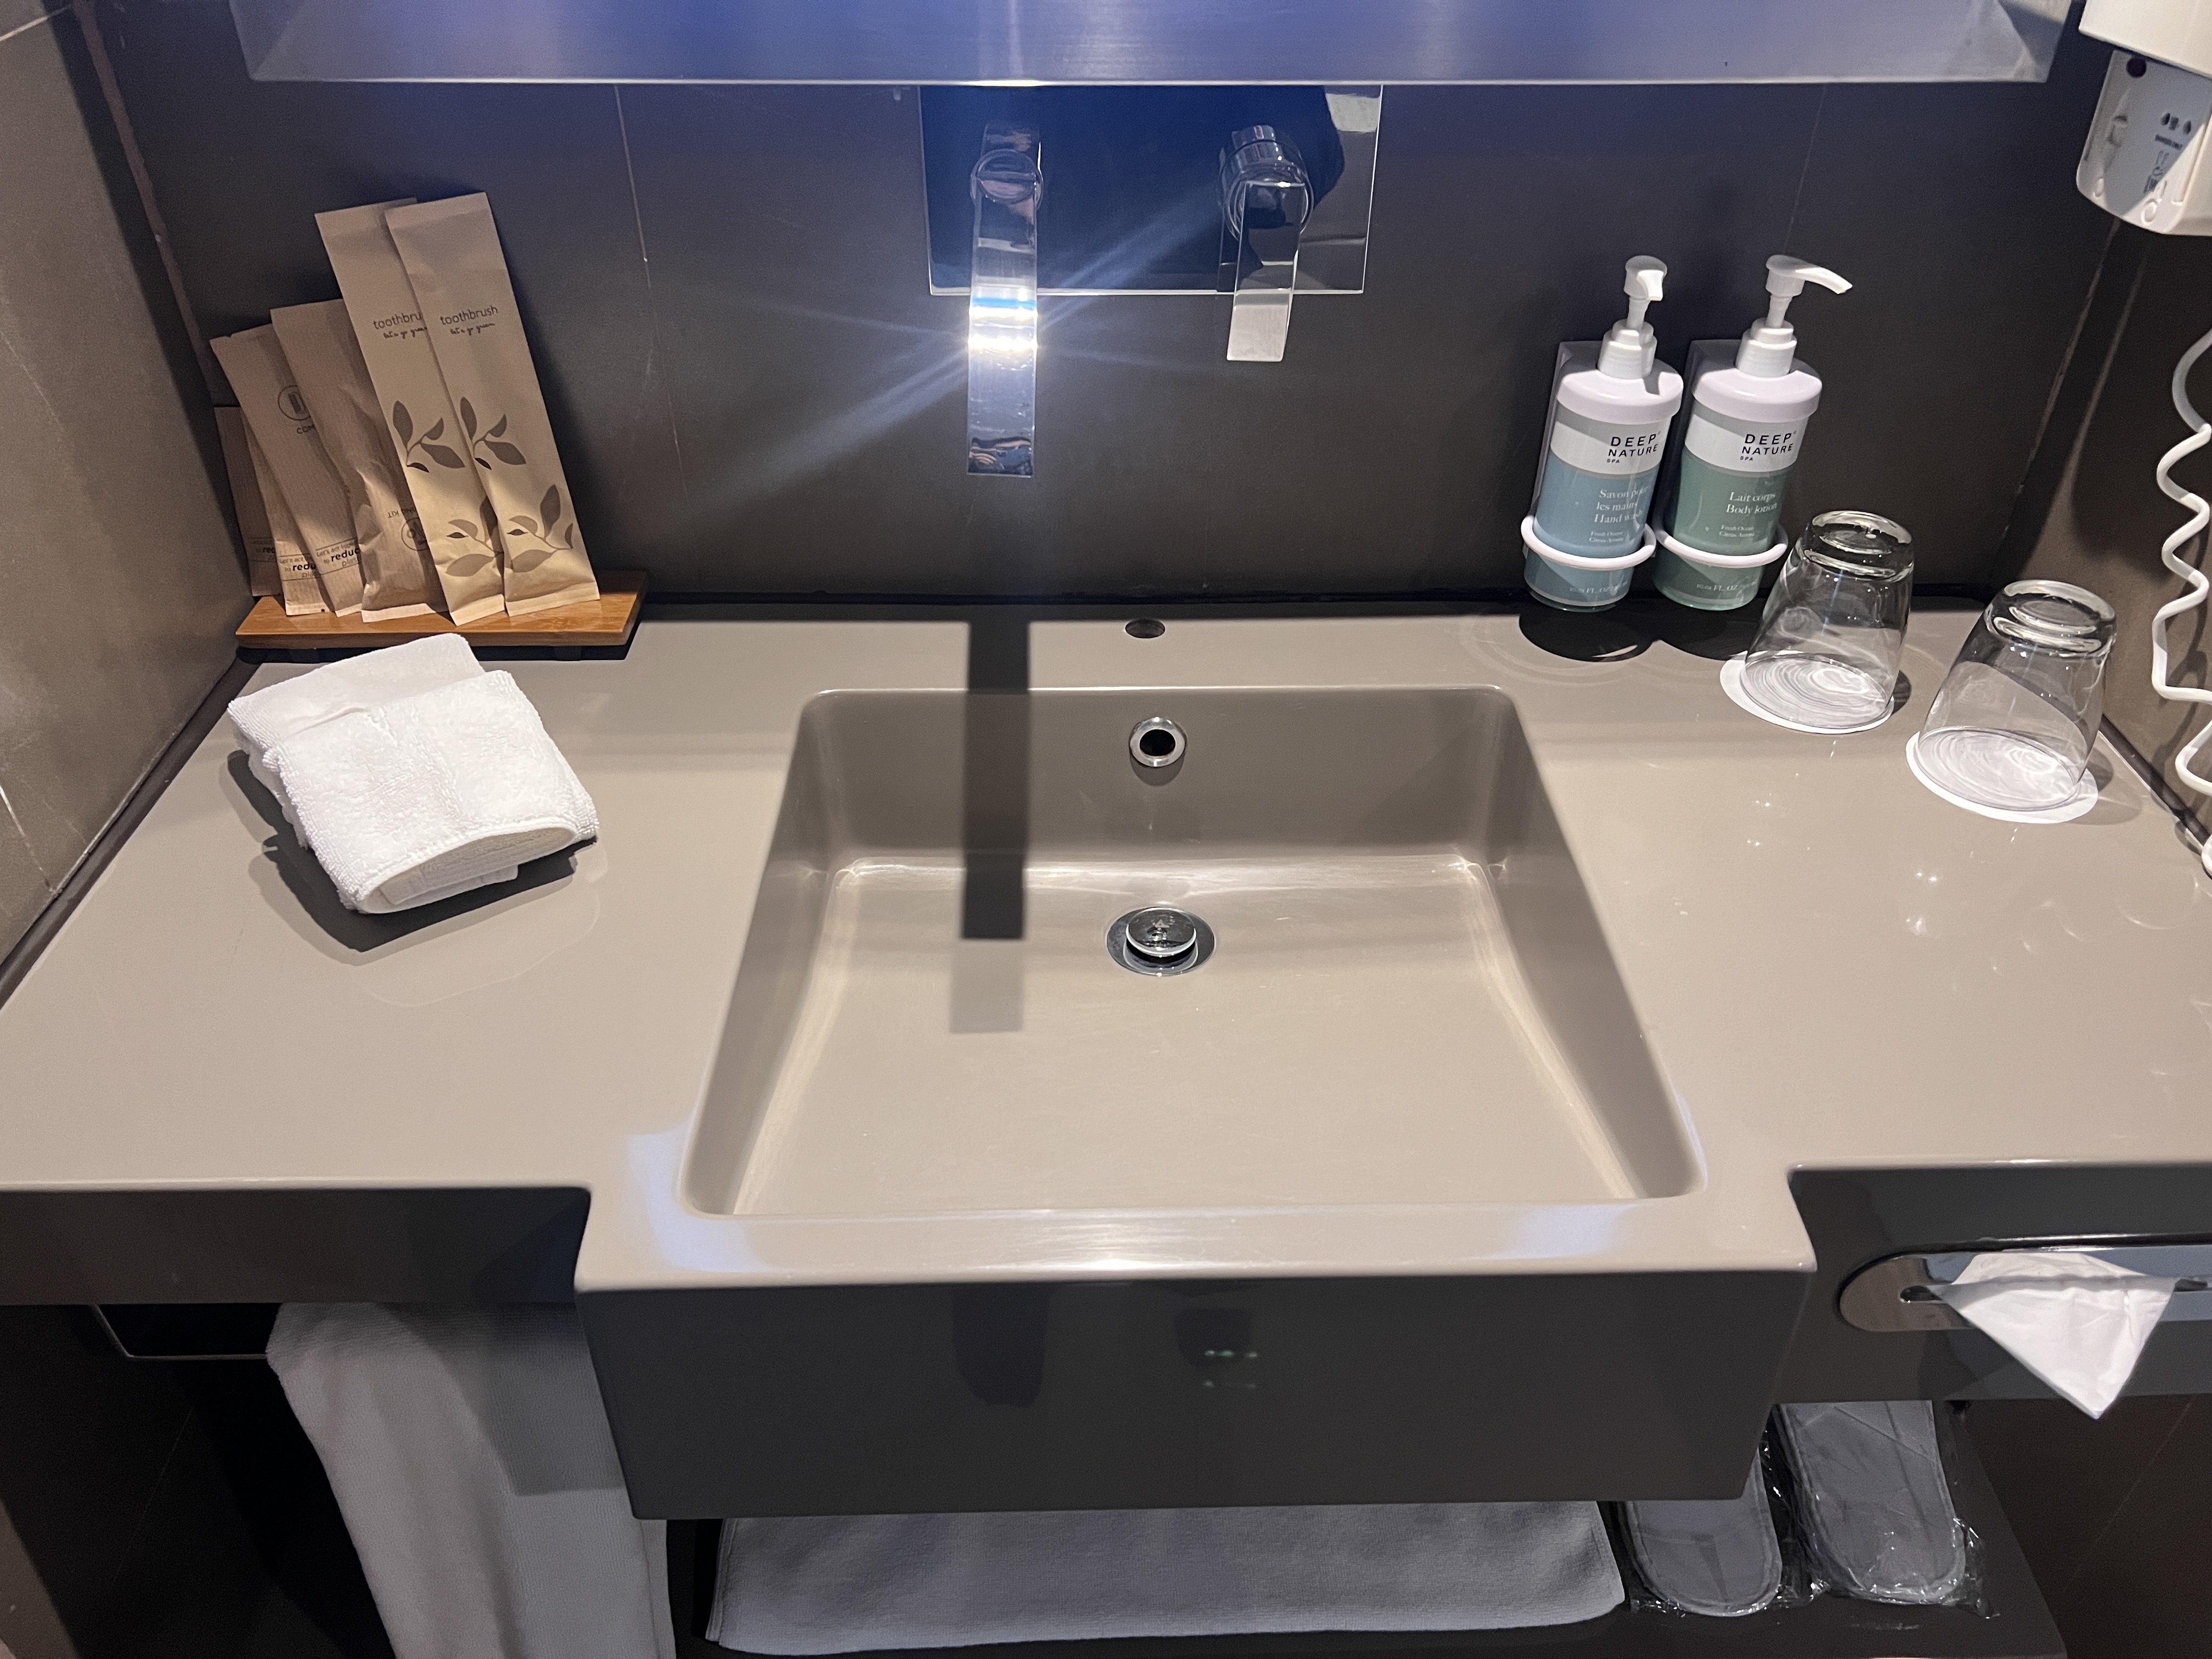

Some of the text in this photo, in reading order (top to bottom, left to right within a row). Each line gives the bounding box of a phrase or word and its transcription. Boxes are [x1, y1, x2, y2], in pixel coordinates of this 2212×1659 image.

[440, 305, 498, 325] toothbrush
[373, 312, 422, 330] toothbru
[297, 424, 315, 434] COM
[1611, 434, 1656, 447] DEEP
[1745, 433, 1792, 445] DEEP
[1608, 444, 1658, 457] NATURE
[1741, 443, 1793, 455] NATURE
[1599, 489, 1629, 499] Savon
[1729, 492, 1751, 502] Lait
[1596, 501, 1610, 511] les
[1726, 504, 1753, 516] Body
[387, 510, 399, 518] KIT
[1594, 514, 1622, 523] Hand
[331, 549, 360, 562] reduc
[292, 562, 317, 571] redu
[342, 557, 357, 567] plas
